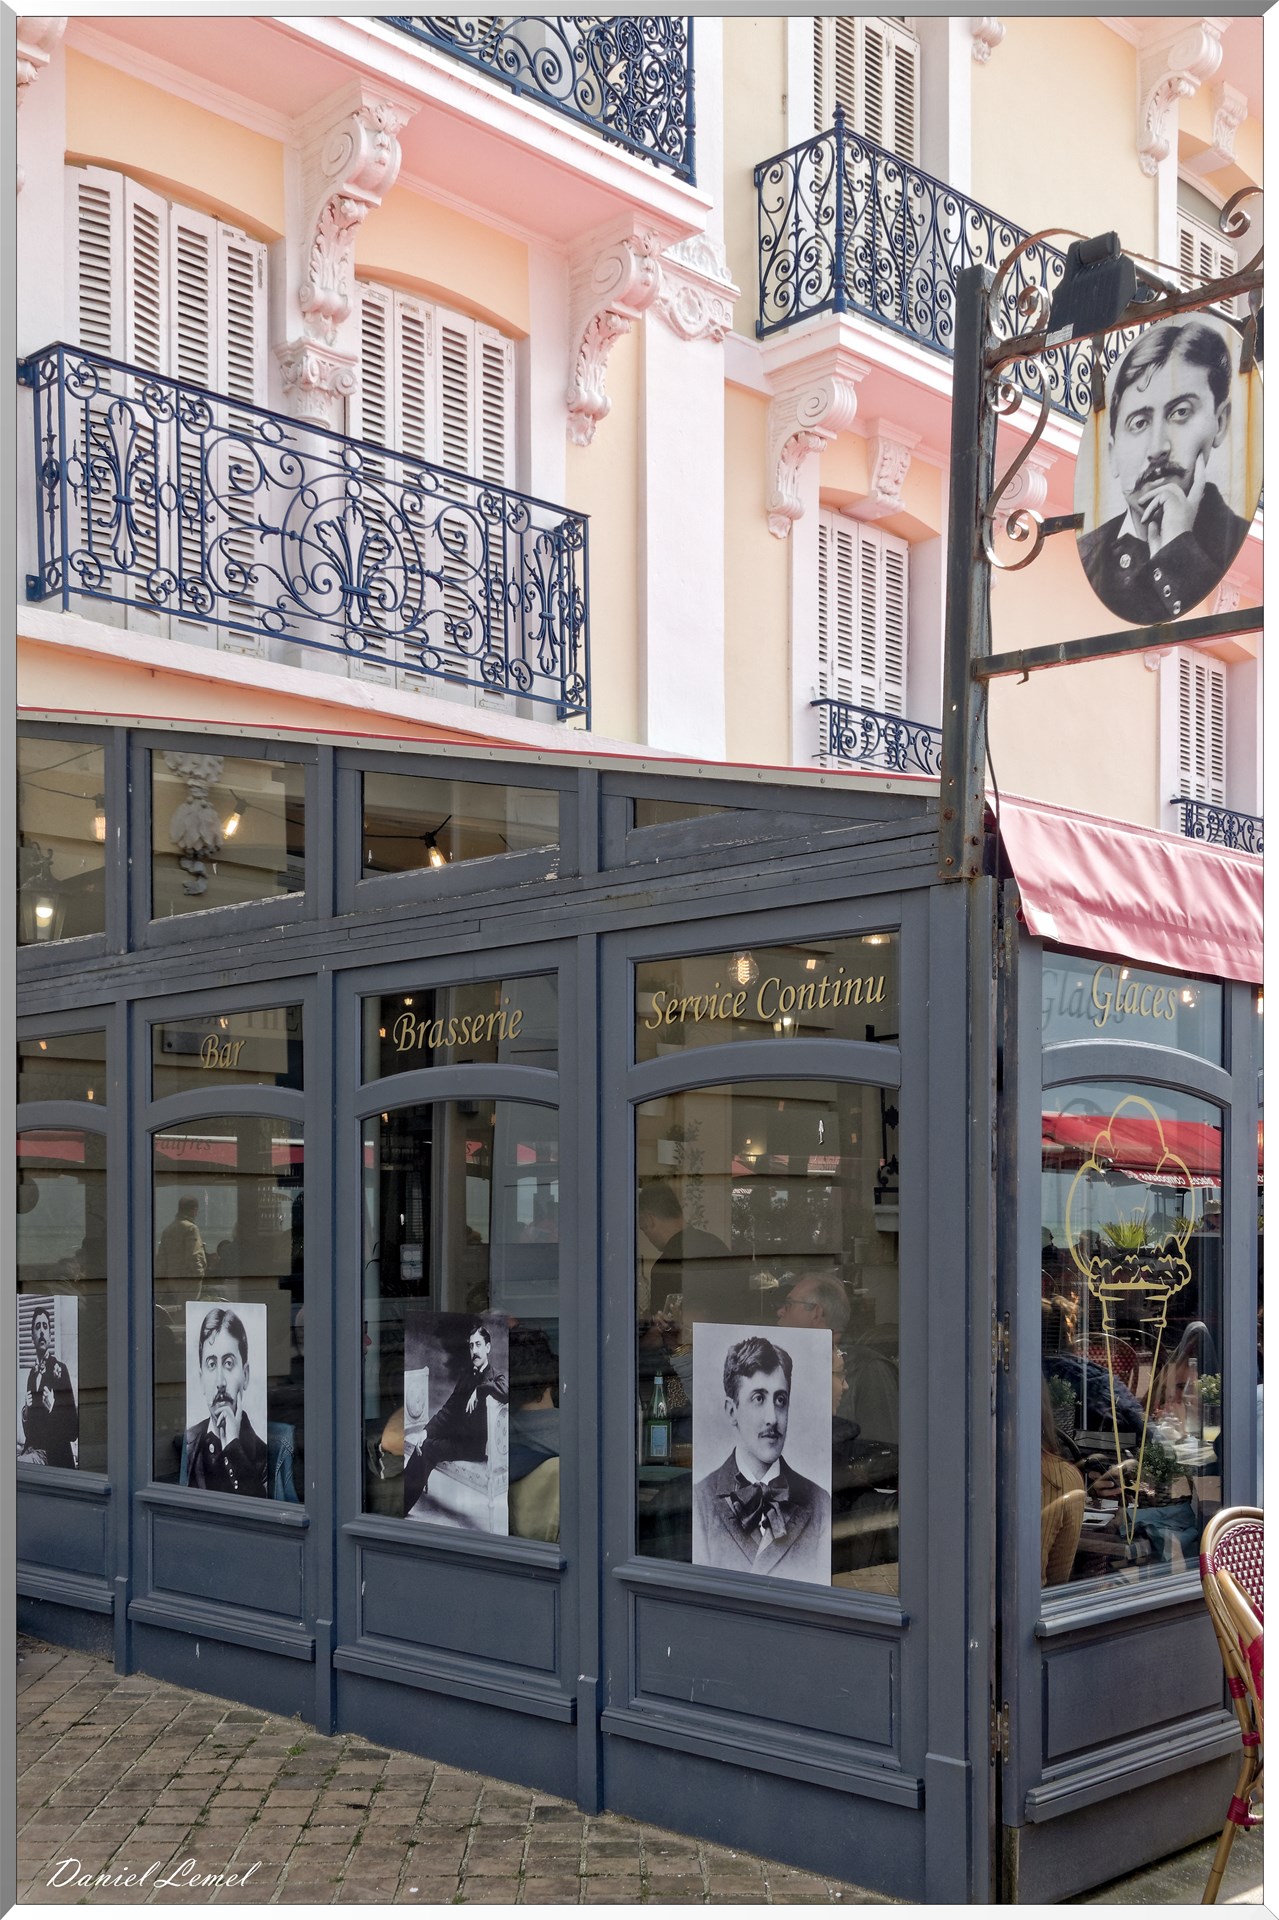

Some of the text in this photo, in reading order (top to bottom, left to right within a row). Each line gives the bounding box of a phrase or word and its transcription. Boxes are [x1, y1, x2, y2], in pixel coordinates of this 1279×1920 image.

[393, 997, 523, 1052] Brasserie
[645, 967, 887, 1030] Service Continu
[1091, 963, 1177, 1028] Glaces
[200, 1033, 247, 1069] Bar
